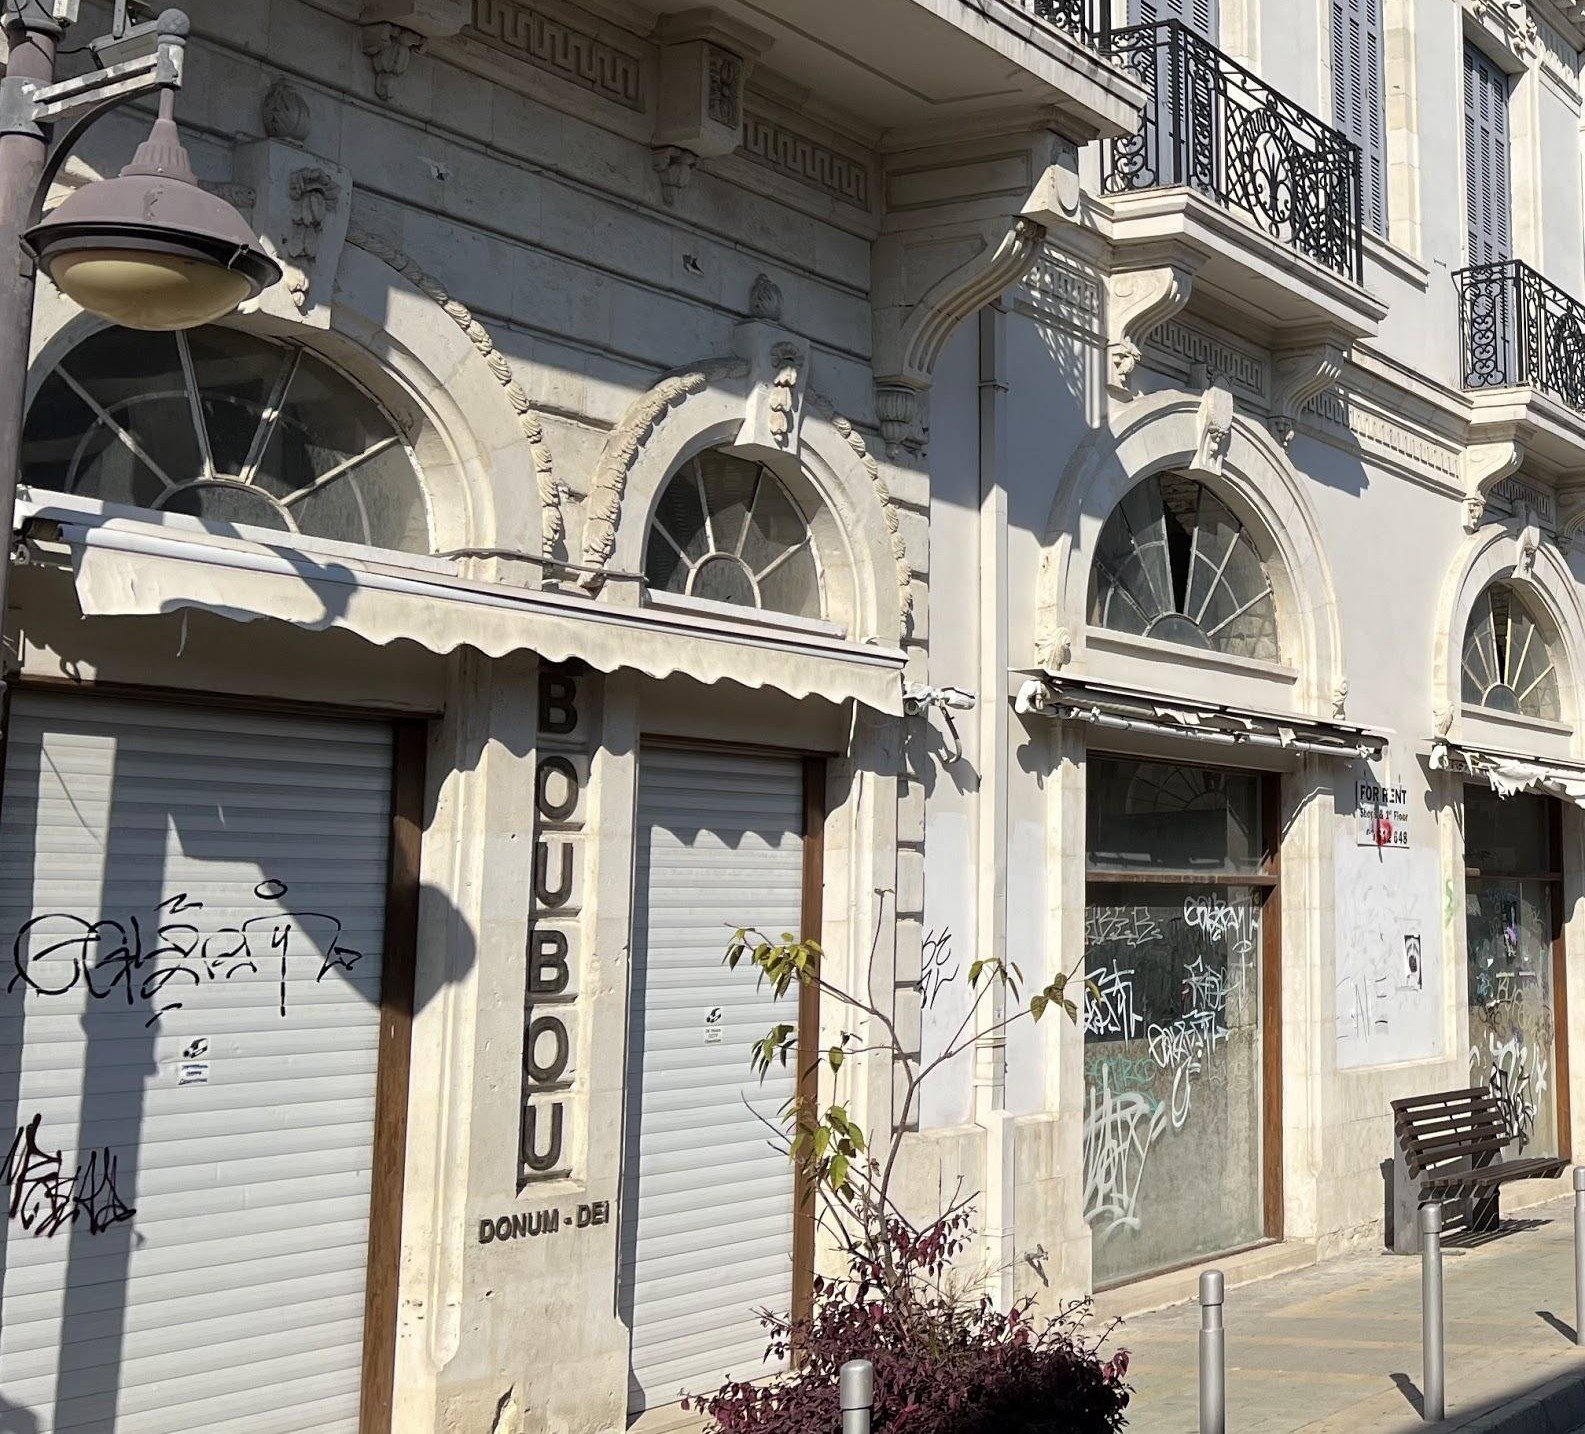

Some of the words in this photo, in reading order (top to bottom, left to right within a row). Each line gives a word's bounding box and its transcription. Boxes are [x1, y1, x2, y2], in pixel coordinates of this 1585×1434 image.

[1360, 785, 1379, 801] FOR
[1382, 788, 1407, 804] RENT
[520, 671, 580, 1172] BOUBOU
[478, 1208, 560, 1244] DONUM
[576, 1200, 609, 1228] DEI
